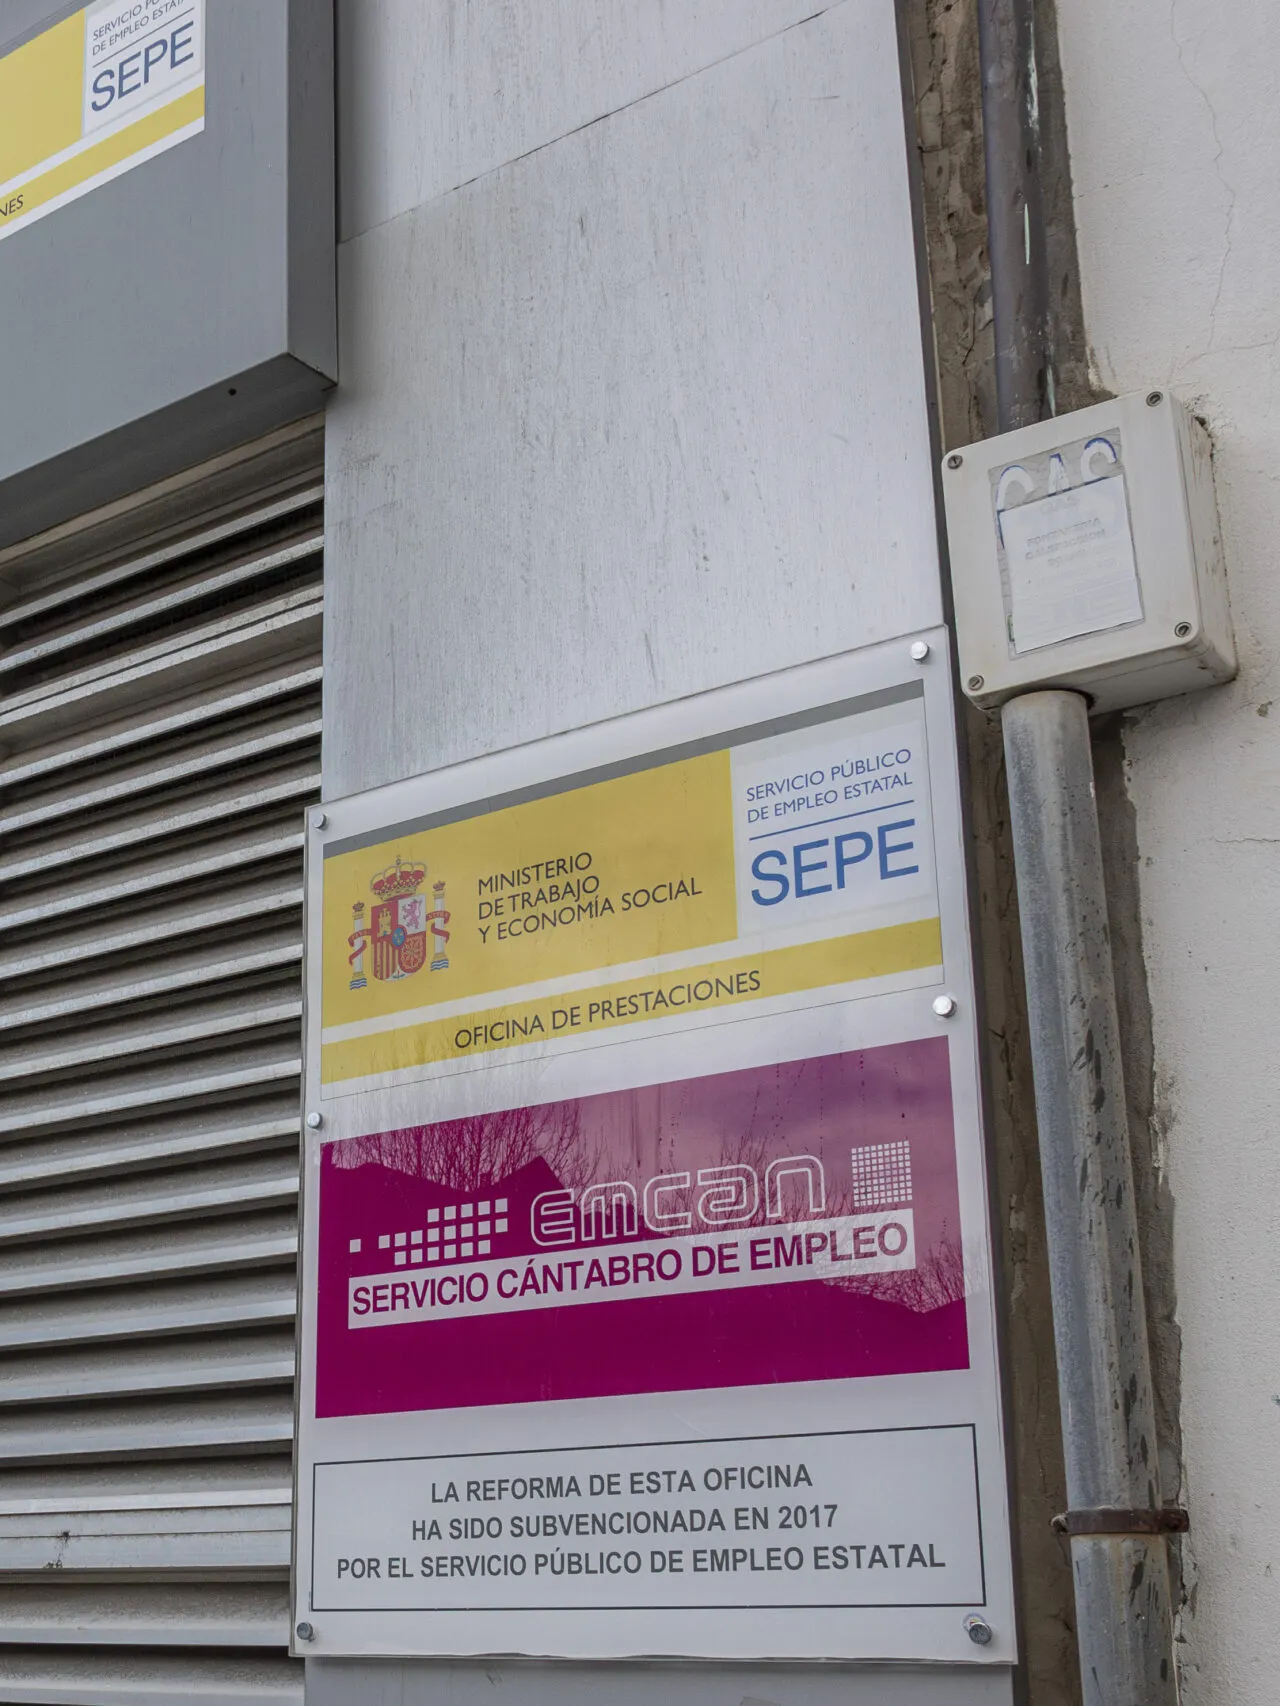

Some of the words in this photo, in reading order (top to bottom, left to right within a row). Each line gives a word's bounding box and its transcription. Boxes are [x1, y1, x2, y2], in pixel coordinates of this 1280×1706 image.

[93, 5, 142, 41] SERVICIO
[93, 40, 107, 56] DE
[109, 15, 149, 46] EMPLEO
[91, 20, 194, 112] SEPE
[746, 770, 825, 802] SERVICIO
[831, 748, 912, 781] PÚBLICO
[747, 805, 769, 823] DE
[774, 790, 838, 817] EMPLEO
[844, 772, 913, 800] ESTATAL
[478, 852, 592, 896] MINISTERIO
[751, 818, 919, 906] SEPE
[478, 898, 504, 920] DE
[507, 875, 600, 912] TRABAJO
[478, 925, 490, 944] Y
[497, 895, 615, 941] ECONOMÍA
[622, 877, 703, 911] SOCIAL
[454, 1014, 544, 1049] OFICINA
[552, 1006, 581, 1030] DE
[588, 970, 761, 1022] PRESTACIONES
[530, 1155, 826, 1247] emcan
[353, 1272, 489, 1316] SERVICIO
[496, 1249, 682, 1305] CÁNTABRO
[692, 1241, 740, 1277] DE
[750, 1222, 908, 1271] EMPLEO
[431, 1481, 460, 1503] LA
[466, 1475, 582, 1502] REFORMA
[589, 1473, 621, 1497] DE
[630, 1470, 696, 1495] ESTA
[703, 1463, 813, 1492] OFICINA
[412, 1519, 442, 1541] HA
[448, 1517, 503, 1540] SIDO
[510, 1508, 726, 1538] SUBVENCIONADA
[734, 1506, 769, 1531] EN
[778, 1504, 838, 1529] 2017
[337, 1557, 381, 1579] POR
[388, 1557, 414, 1578] EL
[420, 1553, 526, 1577] SERVICIO
[534, 1547, 642, 1576] PÚBLICO
[650, 1550, 684, 1573] DE
[693, 1546, 804, 1573] EMPLEO
[813, 1543, 946, 1570] ESTATAL
